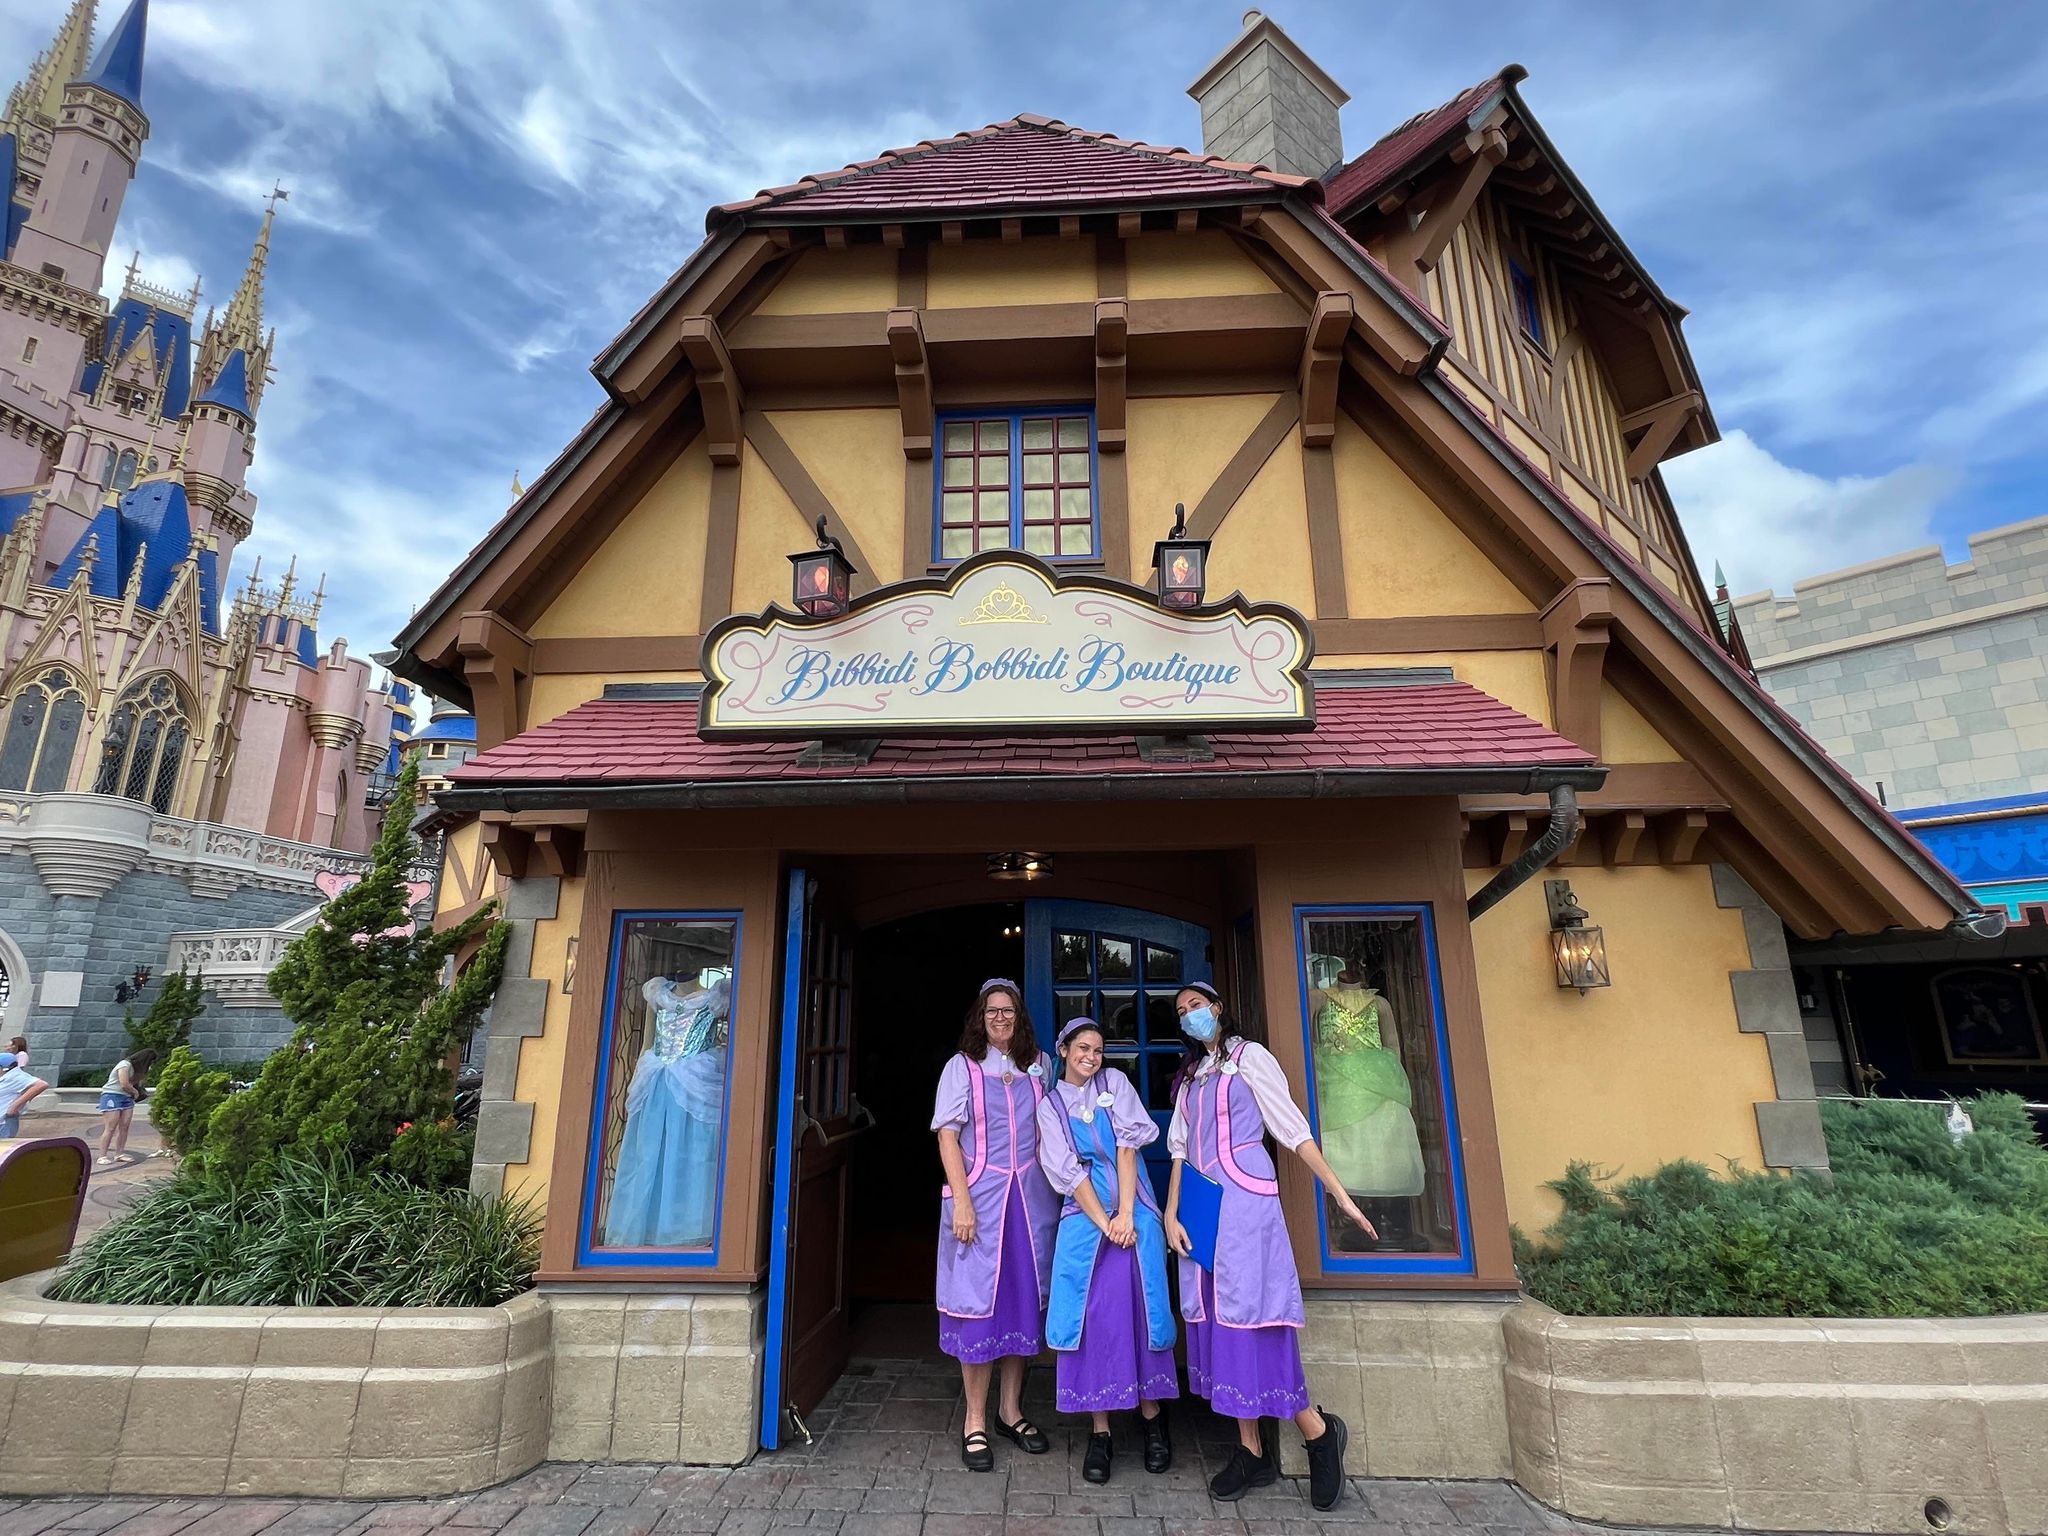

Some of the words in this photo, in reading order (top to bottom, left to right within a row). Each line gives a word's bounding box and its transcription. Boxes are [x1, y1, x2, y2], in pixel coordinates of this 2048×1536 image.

[767, 645, 918, 704] Bibbidi
[910, 636, 1068, 695] Bobbidi
[1061, 635, 1241, 703] Boutique
